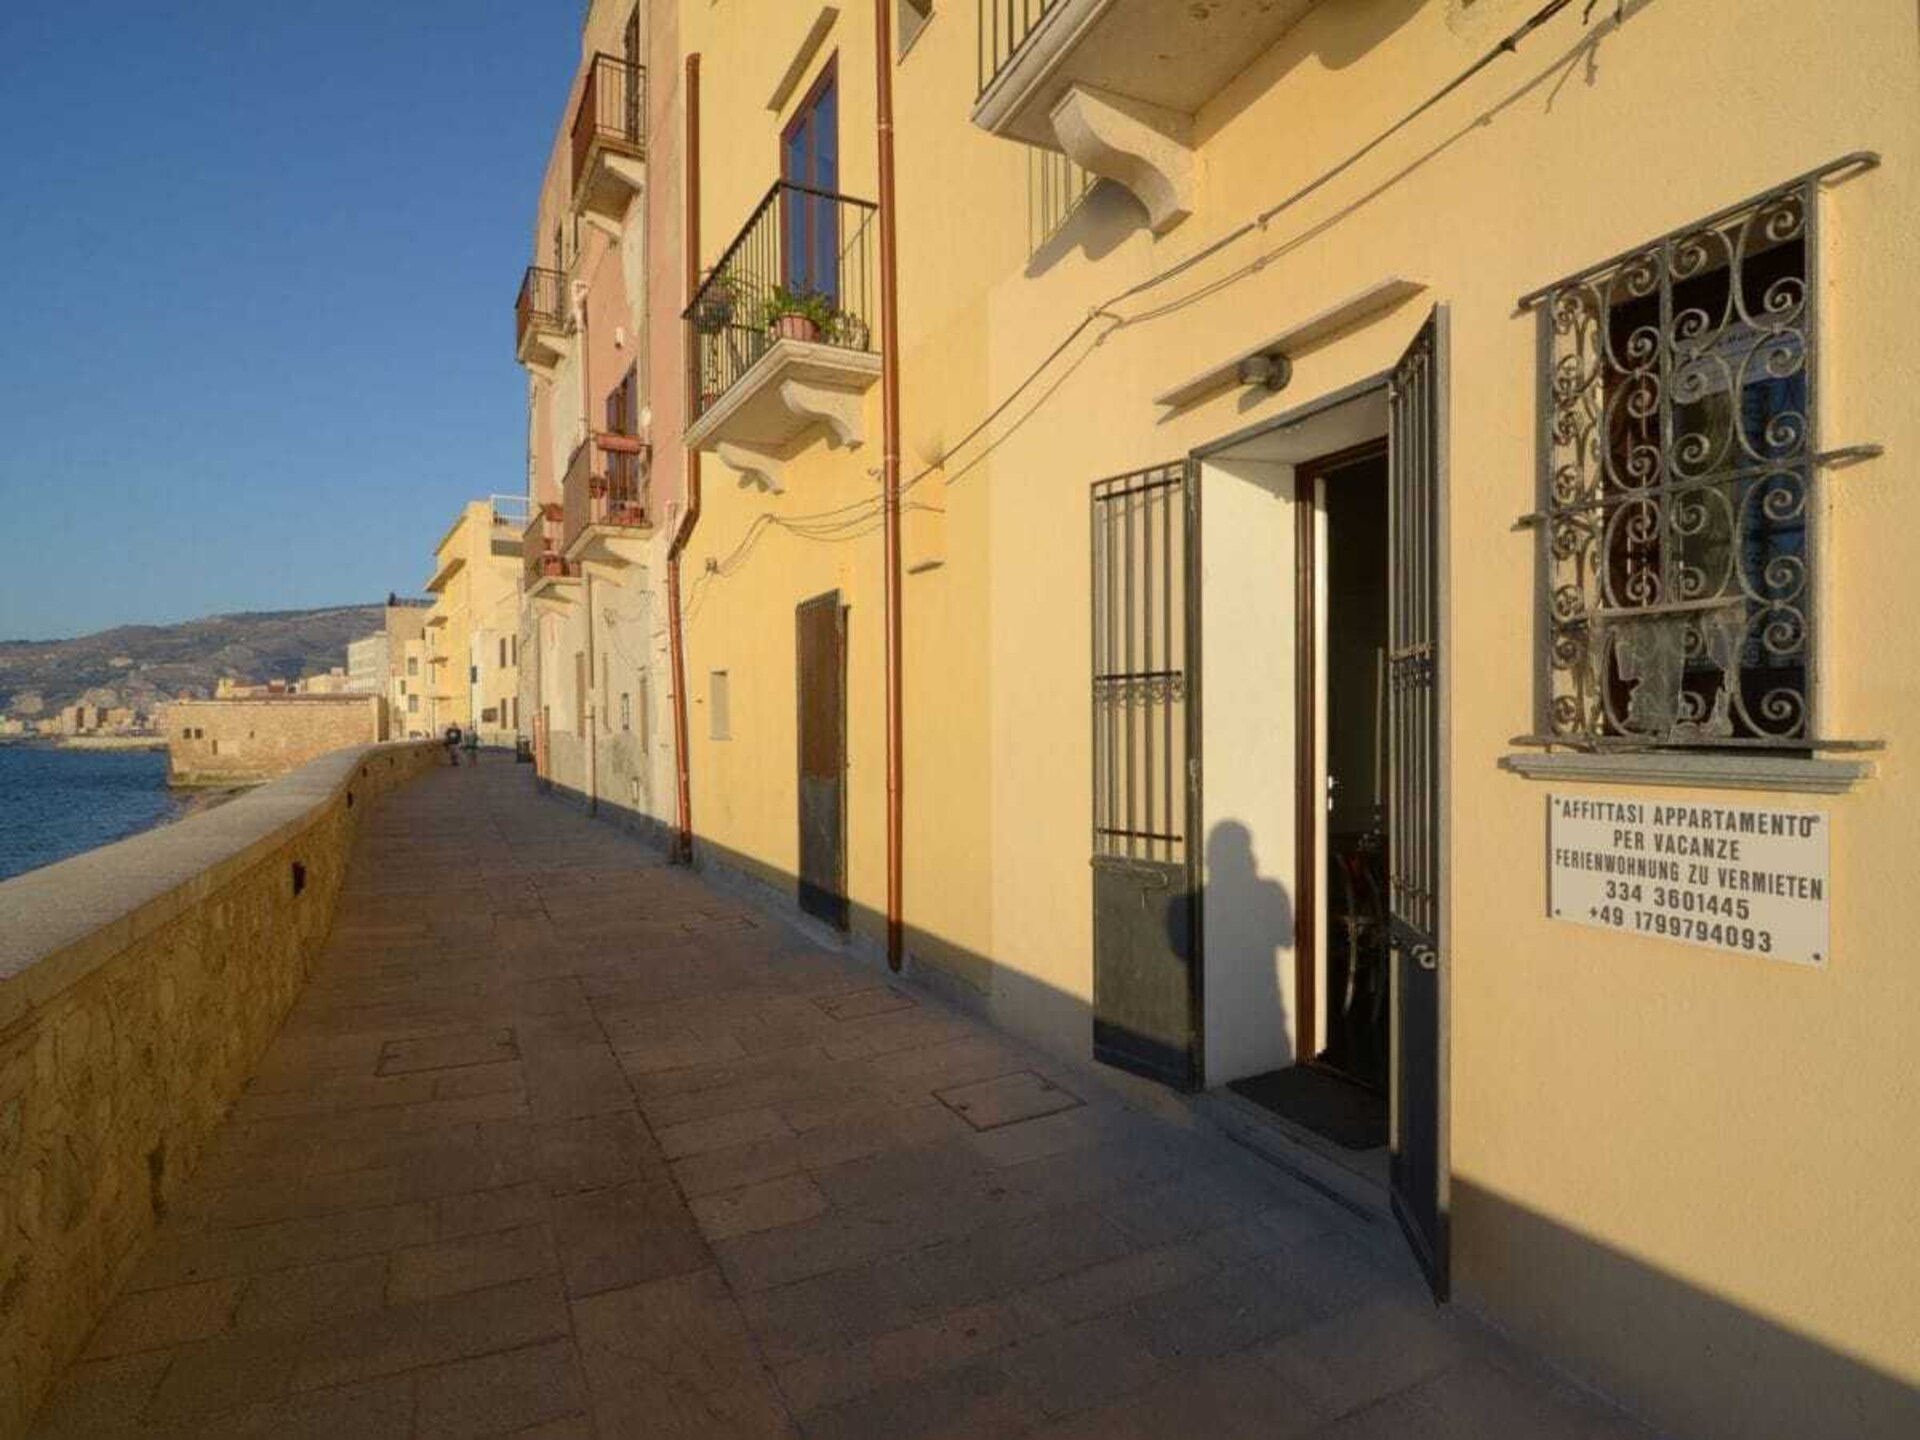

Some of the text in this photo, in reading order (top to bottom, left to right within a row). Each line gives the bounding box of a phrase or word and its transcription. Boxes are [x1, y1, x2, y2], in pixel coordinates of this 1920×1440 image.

[1563, 801, 1812, 838] AFFITTASI APPARTAMENTO
[1614, 829, 1740, 861] PER VACANZE
[1556, 849, 1822, 900] FERIENWOHNUNG ZU VERMIETEN
[1606, 880, 1750, 920] 334 3601445
[1590, 905, 1772, 953] +49 1799794093
